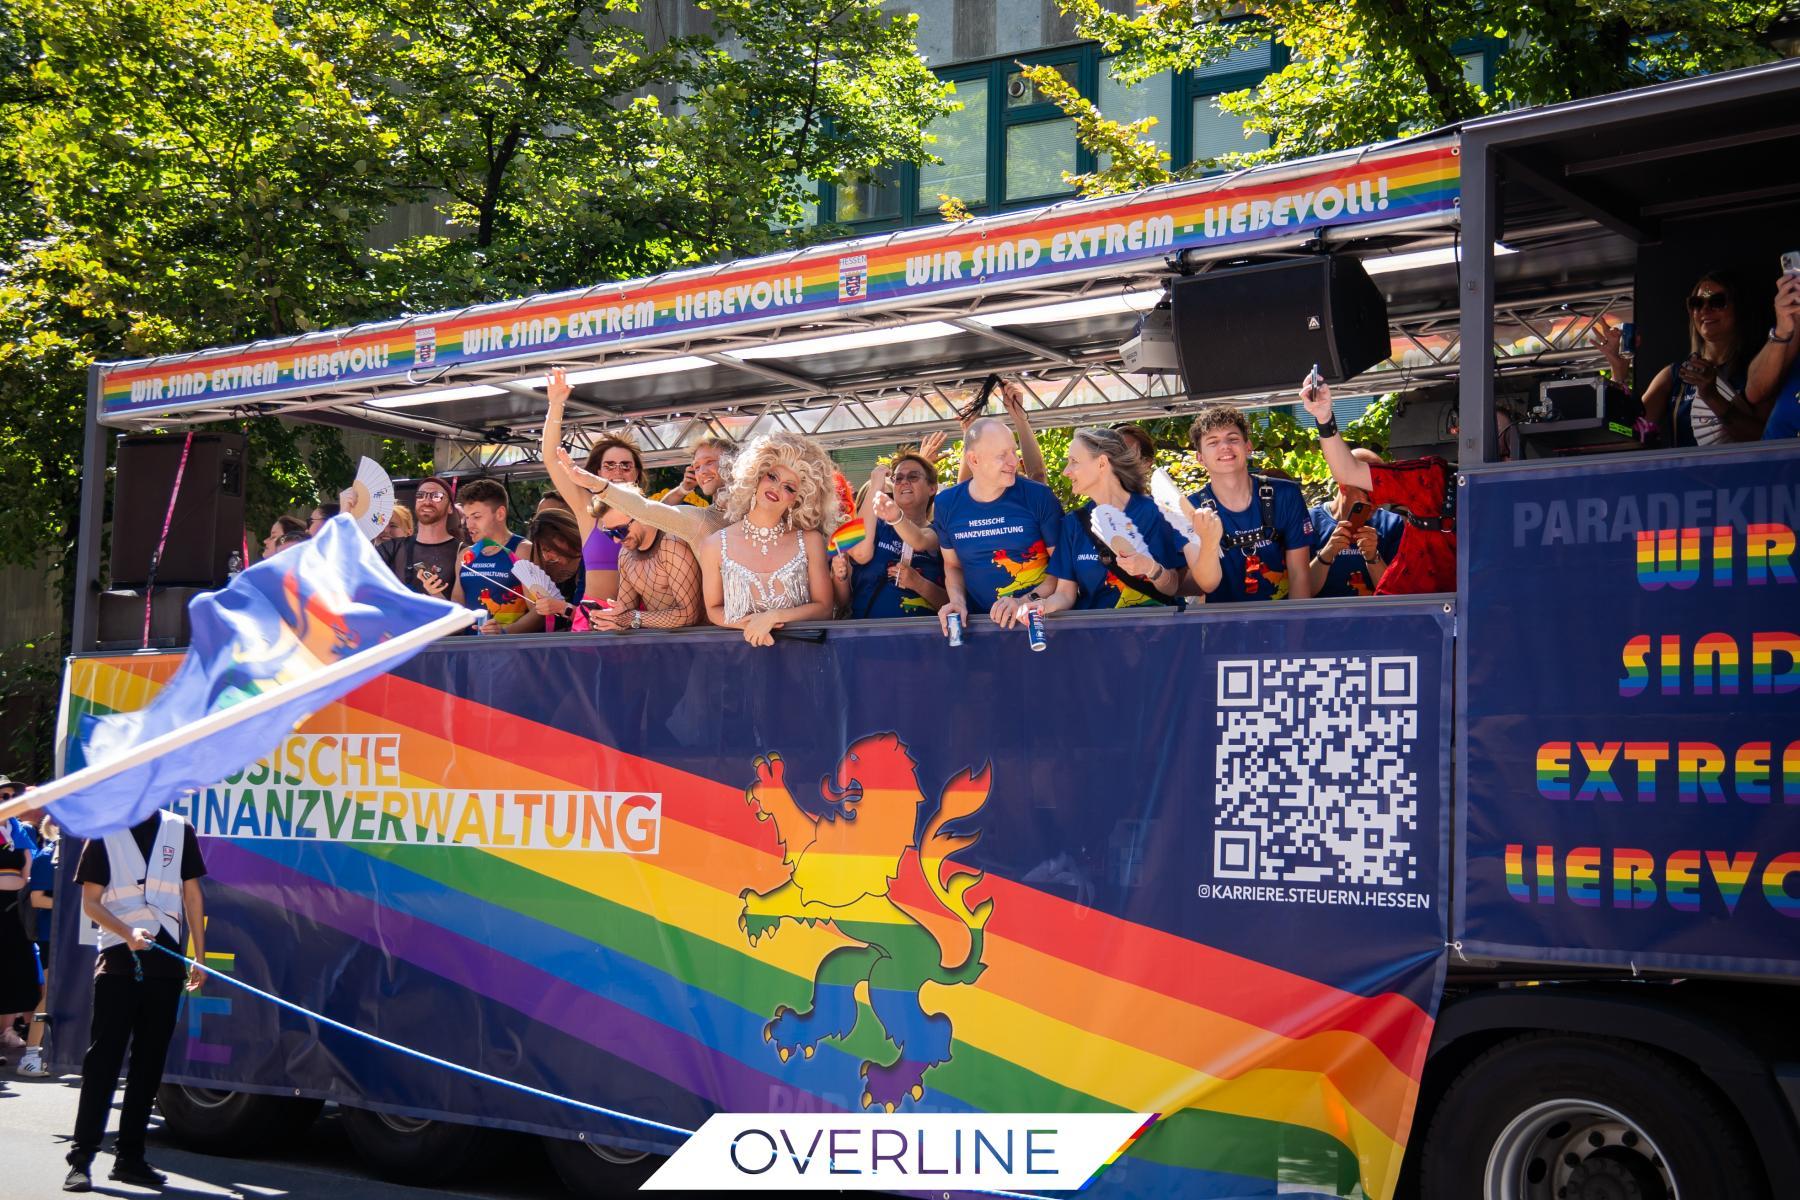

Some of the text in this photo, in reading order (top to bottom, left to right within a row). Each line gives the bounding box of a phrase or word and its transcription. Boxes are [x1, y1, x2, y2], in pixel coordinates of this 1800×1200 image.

[905, 251, 962, 287] WIR
[971, 238, 1041, 277] SIND
[1050, 215, 1174, 263] EXTREM
[1204, 176, 1389, 238] LIEBEVOLL!
[463, 324, 504, 356] WIR
[509, 316, 561, 349] SIND
[567, 300, 655, 339] EXTREM
[675, 275, 804, 322] LIEBEVOLL!
[130, 377, 164, 403] WIR
[167, 371, 208, 399] SIND
[211, 360, 279, 392] EXTREM
[293, 343, 389, 381] LIEBEVOLL!
[954, 525, 1025, 541] FINANZVERWALTUNG
[968, 516, 1006, 528] HESSISCHE
[1636, 522, 1799, 592] WIR
[1618, 631, 1800, 698] SIND
[1212, 884, 1431, 909] KARRIERE.STEUERN.HESSEN
